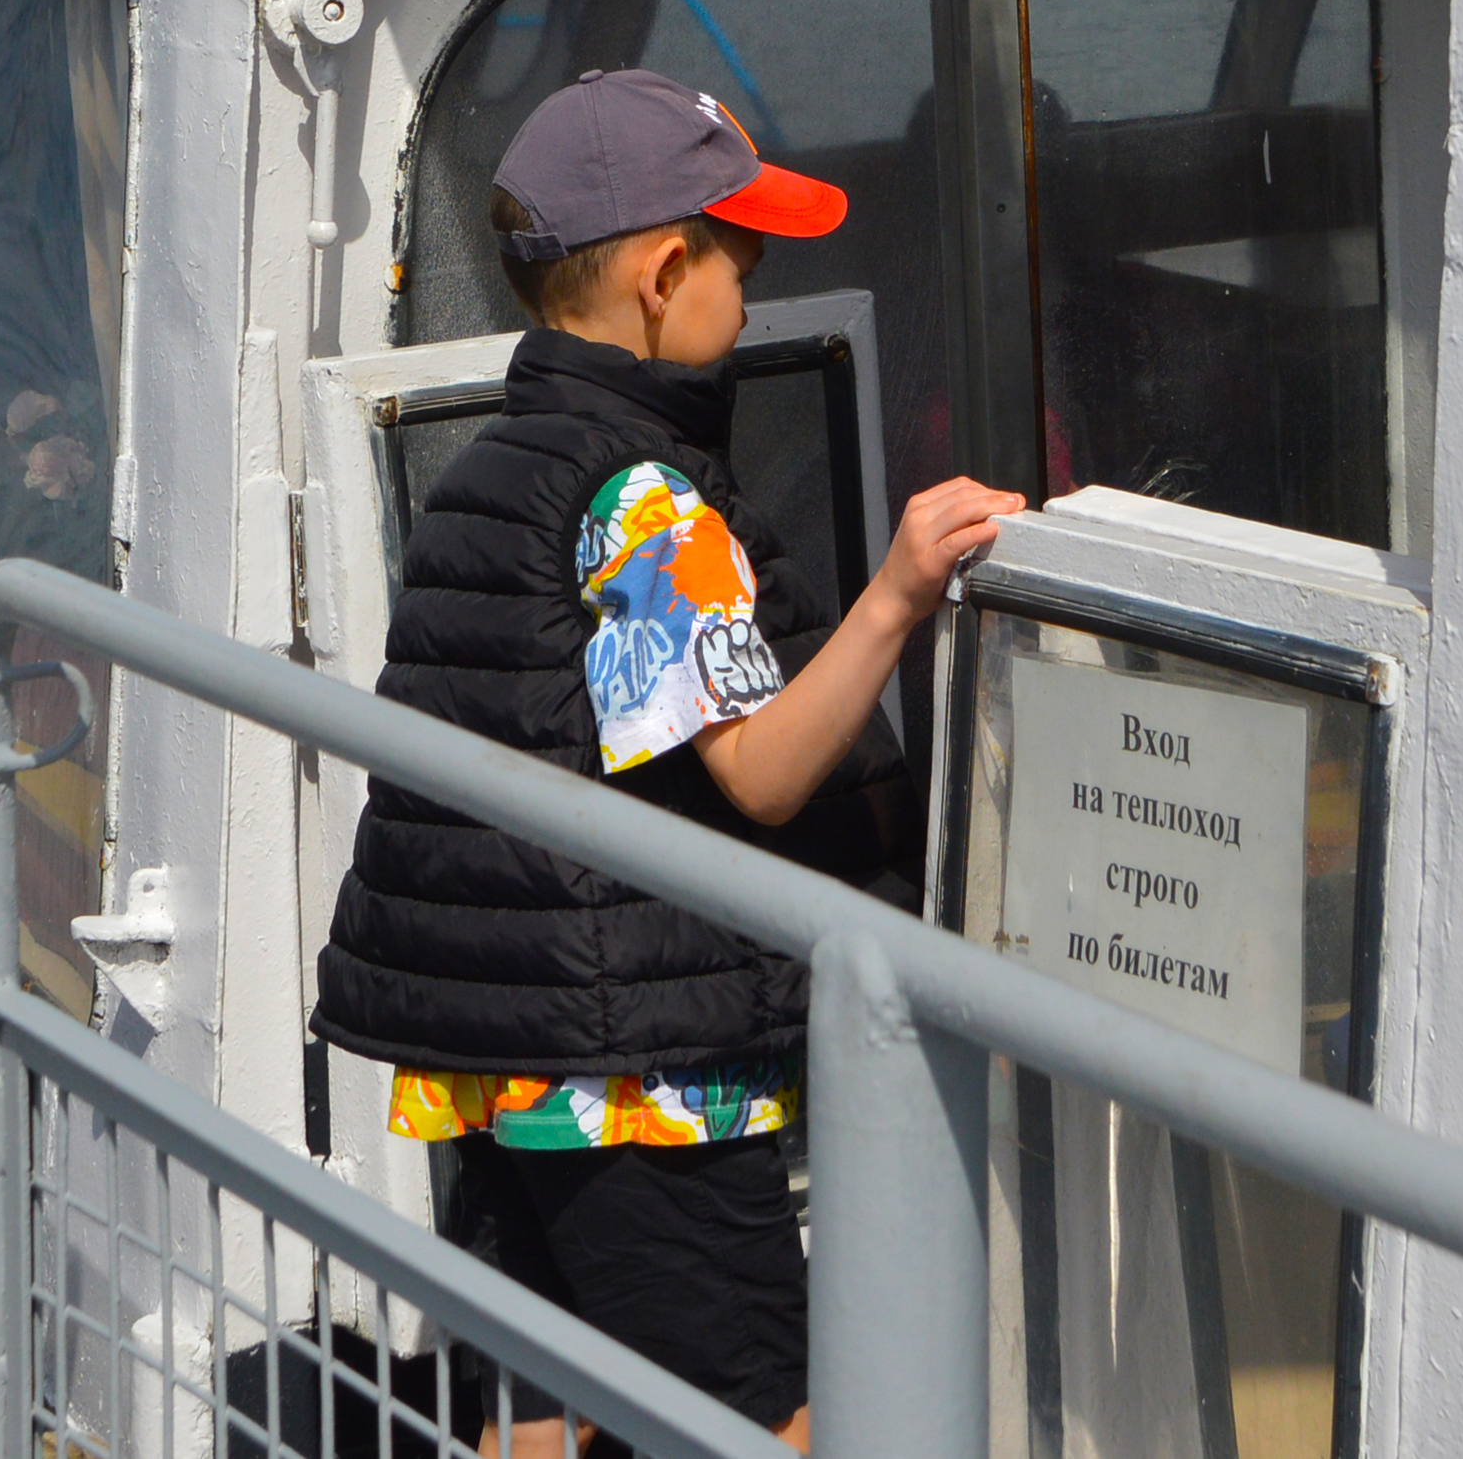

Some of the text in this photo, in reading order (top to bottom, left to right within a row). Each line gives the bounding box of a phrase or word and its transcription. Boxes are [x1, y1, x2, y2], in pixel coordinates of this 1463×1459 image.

[1121, 713, 1191, 768] Вход
[1072, 782, 1241, 851] на теплоход
[1106, 861, 1199, 909] строго
[1067, 932, 1230, 1000] по билетам
